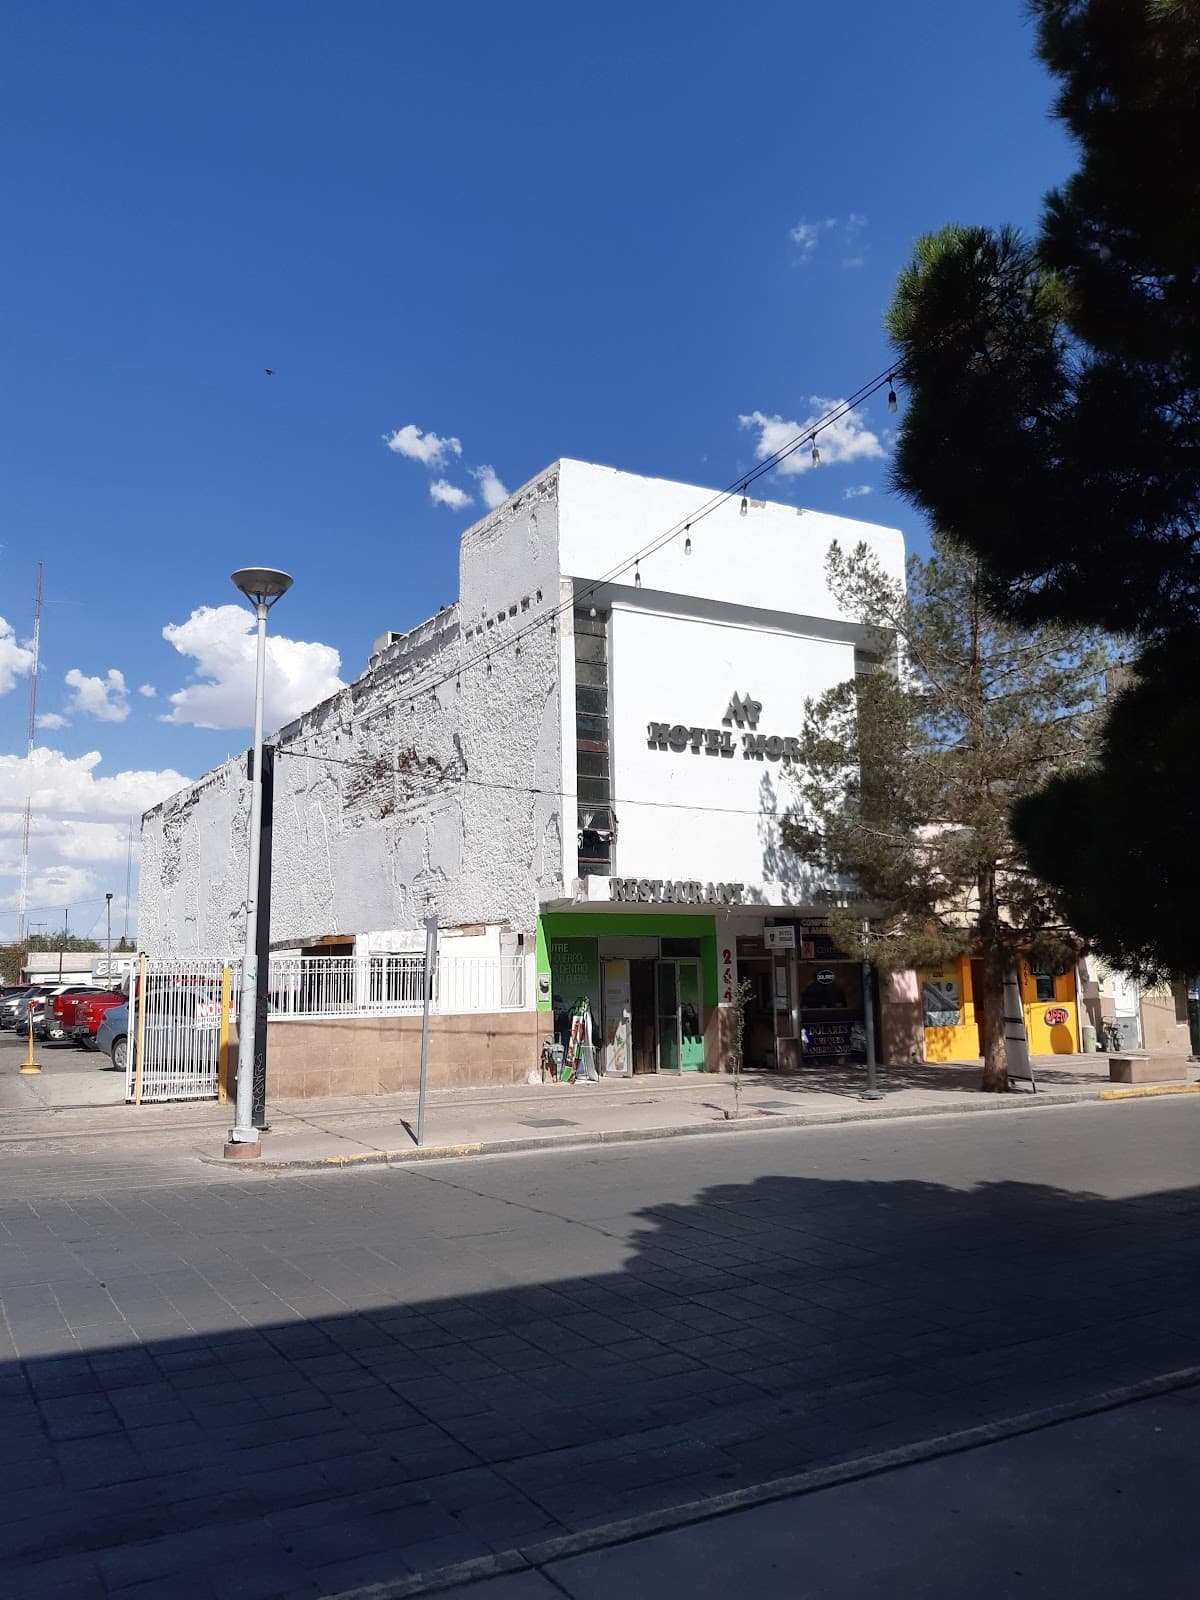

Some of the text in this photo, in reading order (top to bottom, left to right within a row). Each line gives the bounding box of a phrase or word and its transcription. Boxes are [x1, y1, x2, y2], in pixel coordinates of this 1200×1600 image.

[647, 721, 804, 764] HOTEL MOR
[608, 877, 745, 905] RESTAURANT
[1046, 1009, 1068, 1023] OPEN
